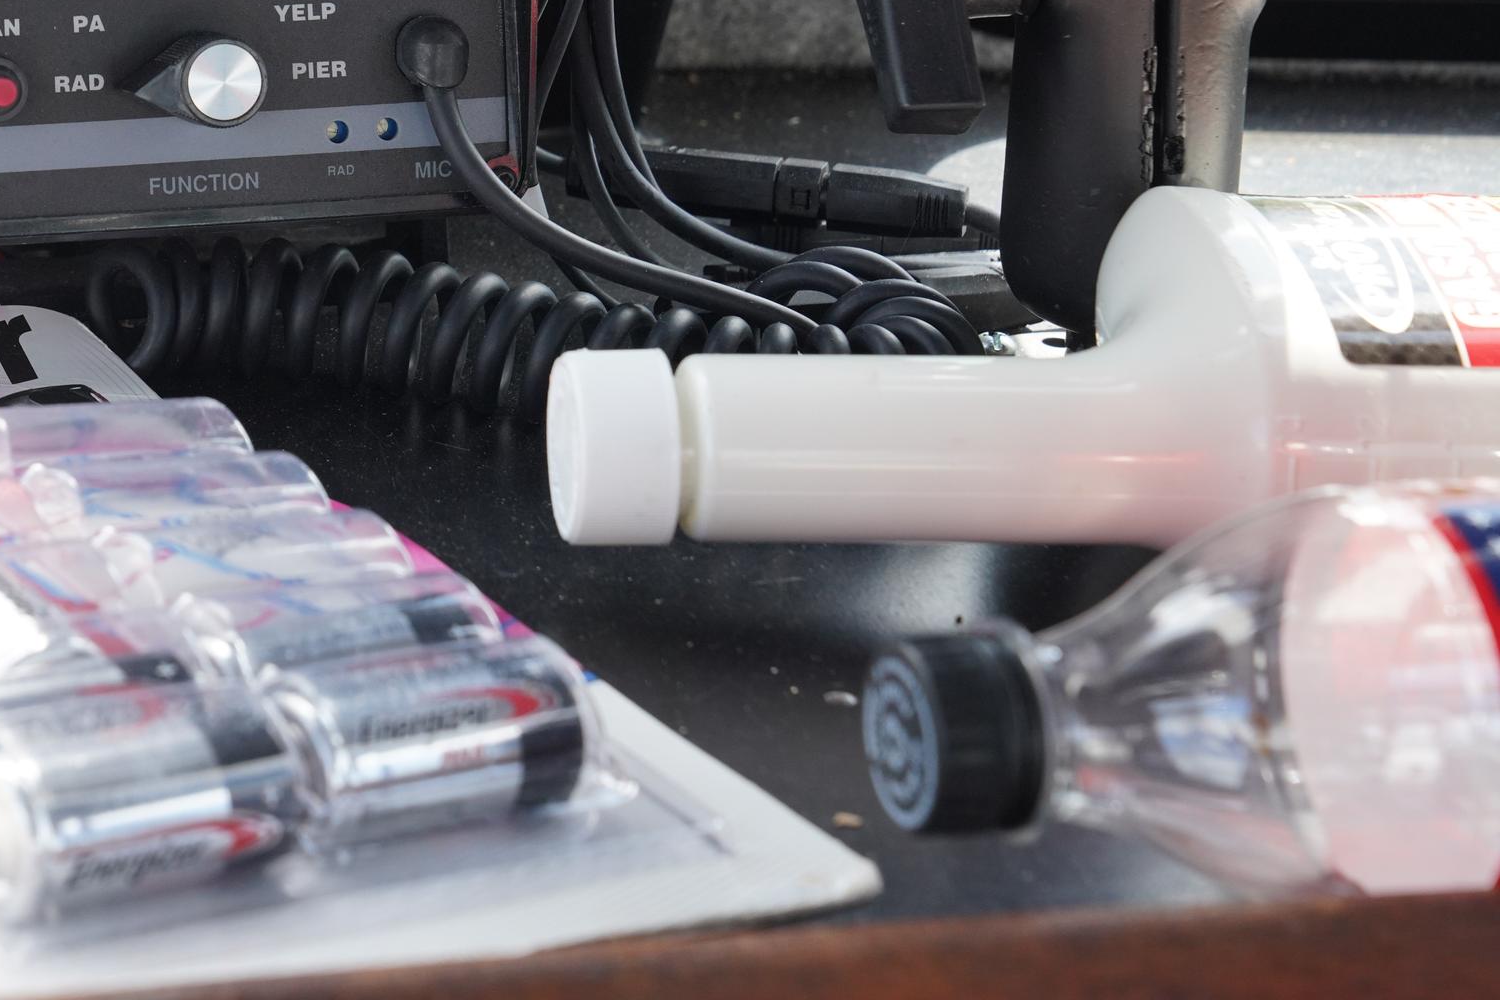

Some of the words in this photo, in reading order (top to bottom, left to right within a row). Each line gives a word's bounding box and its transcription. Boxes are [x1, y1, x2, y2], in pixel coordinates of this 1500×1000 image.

[273, 2, 336, 22] YELP
[72, 14, 106, 33] PA
[291, 60, 347, 80] PIER
[53, 73, 105, 93] RAD
[327, 164, 355, 177] RAD
[414, 159, 452, 179] MIC
[148, 171, 260, 196] FUNCTION
